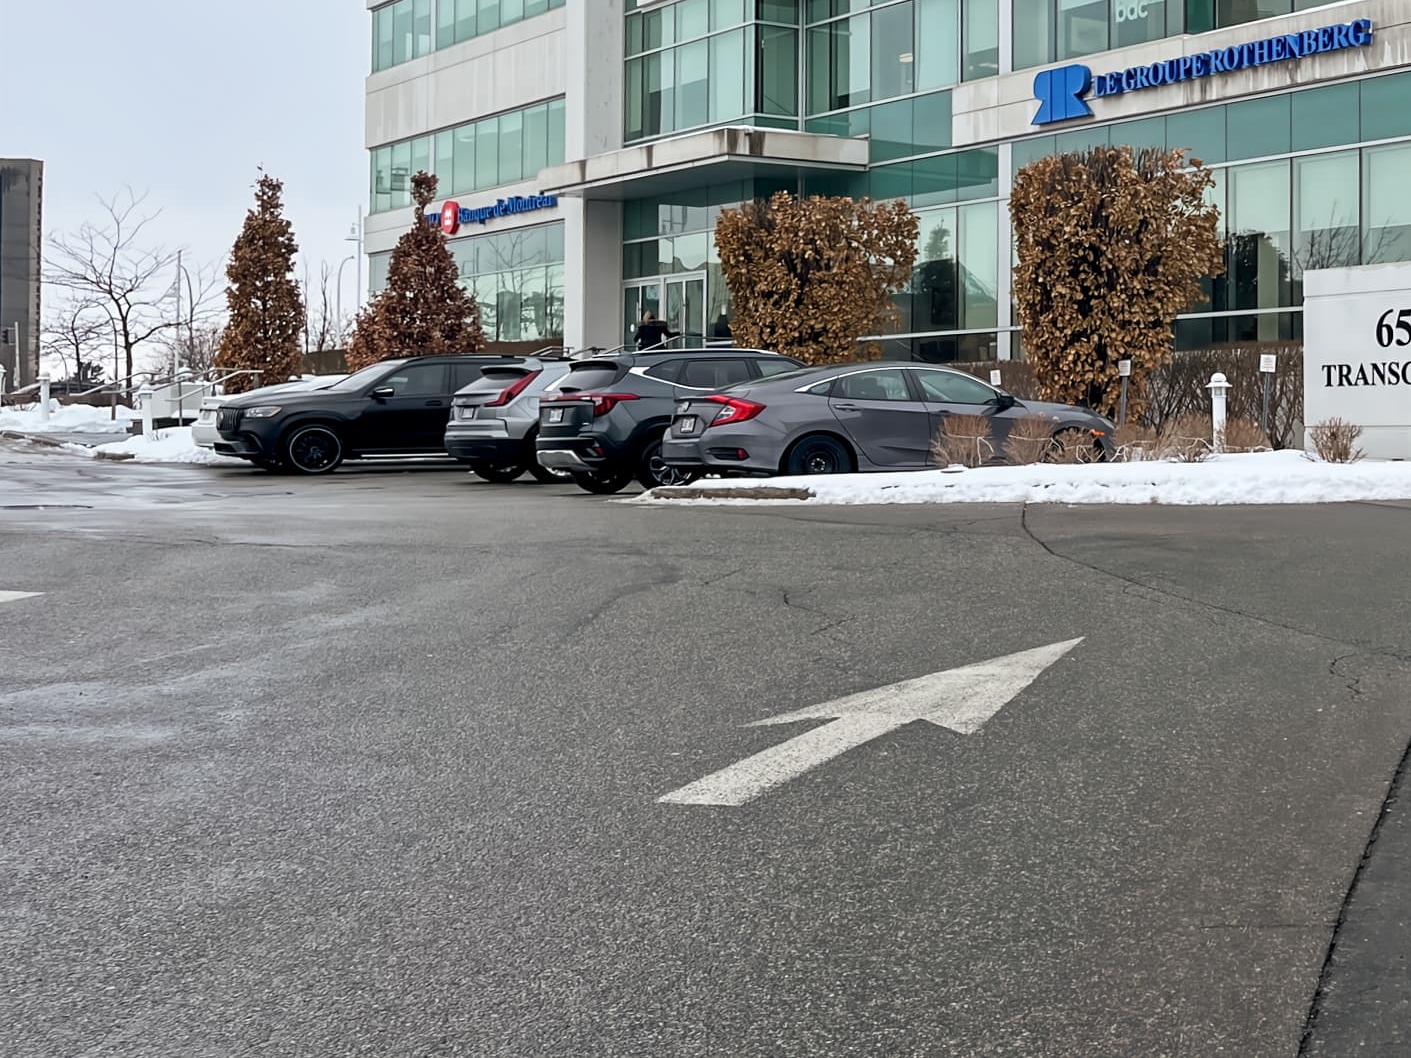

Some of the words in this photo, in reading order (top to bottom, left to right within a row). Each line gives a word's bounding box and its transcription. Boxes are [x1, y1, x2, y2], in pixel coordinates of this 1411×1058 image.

[1093, 72, 1122, 98] LE
[1121, 53, 1209, 90] GROUPE
[1208, 19, 1372, 74] ROTHENBERG
[458, 207, 492, 225] Banque
